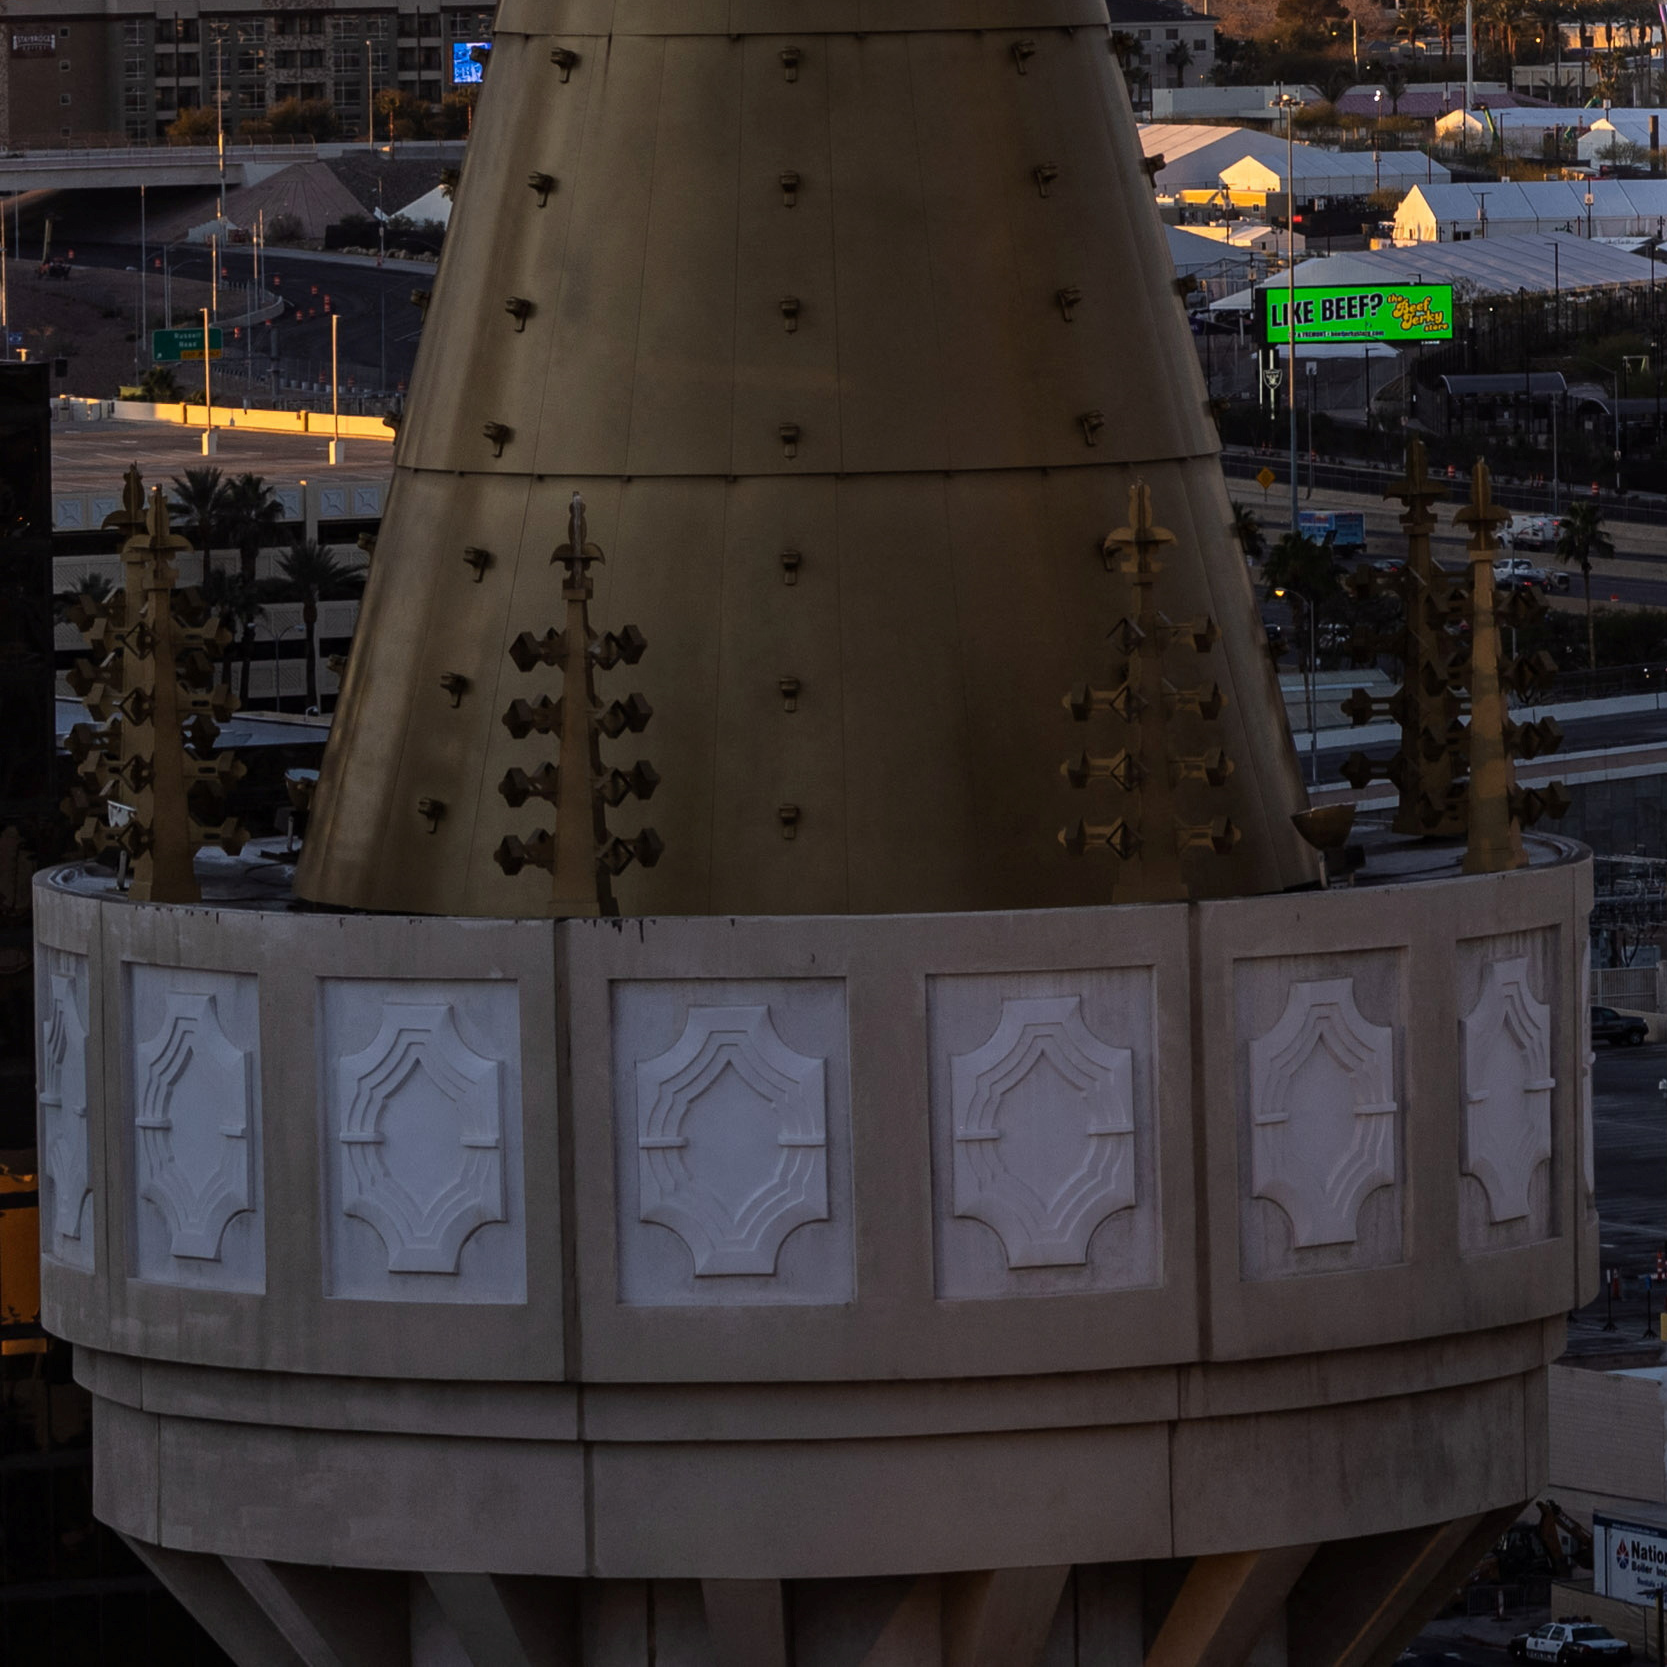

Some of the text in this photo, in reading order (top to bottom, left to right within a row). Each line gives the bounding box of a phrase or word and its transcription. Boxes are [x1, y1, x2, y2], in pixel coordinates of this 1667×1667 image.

[1387, 293, 1403, 303] the
[1321, 293, 1384, 322] BEEF?
[1392, 295, 1432, 319] Beef
[1400, 310, 1443, 331] Jerky
[1424, 322, 1449, 332] store
[1631, 1561, 1652, 1575] Boiler
